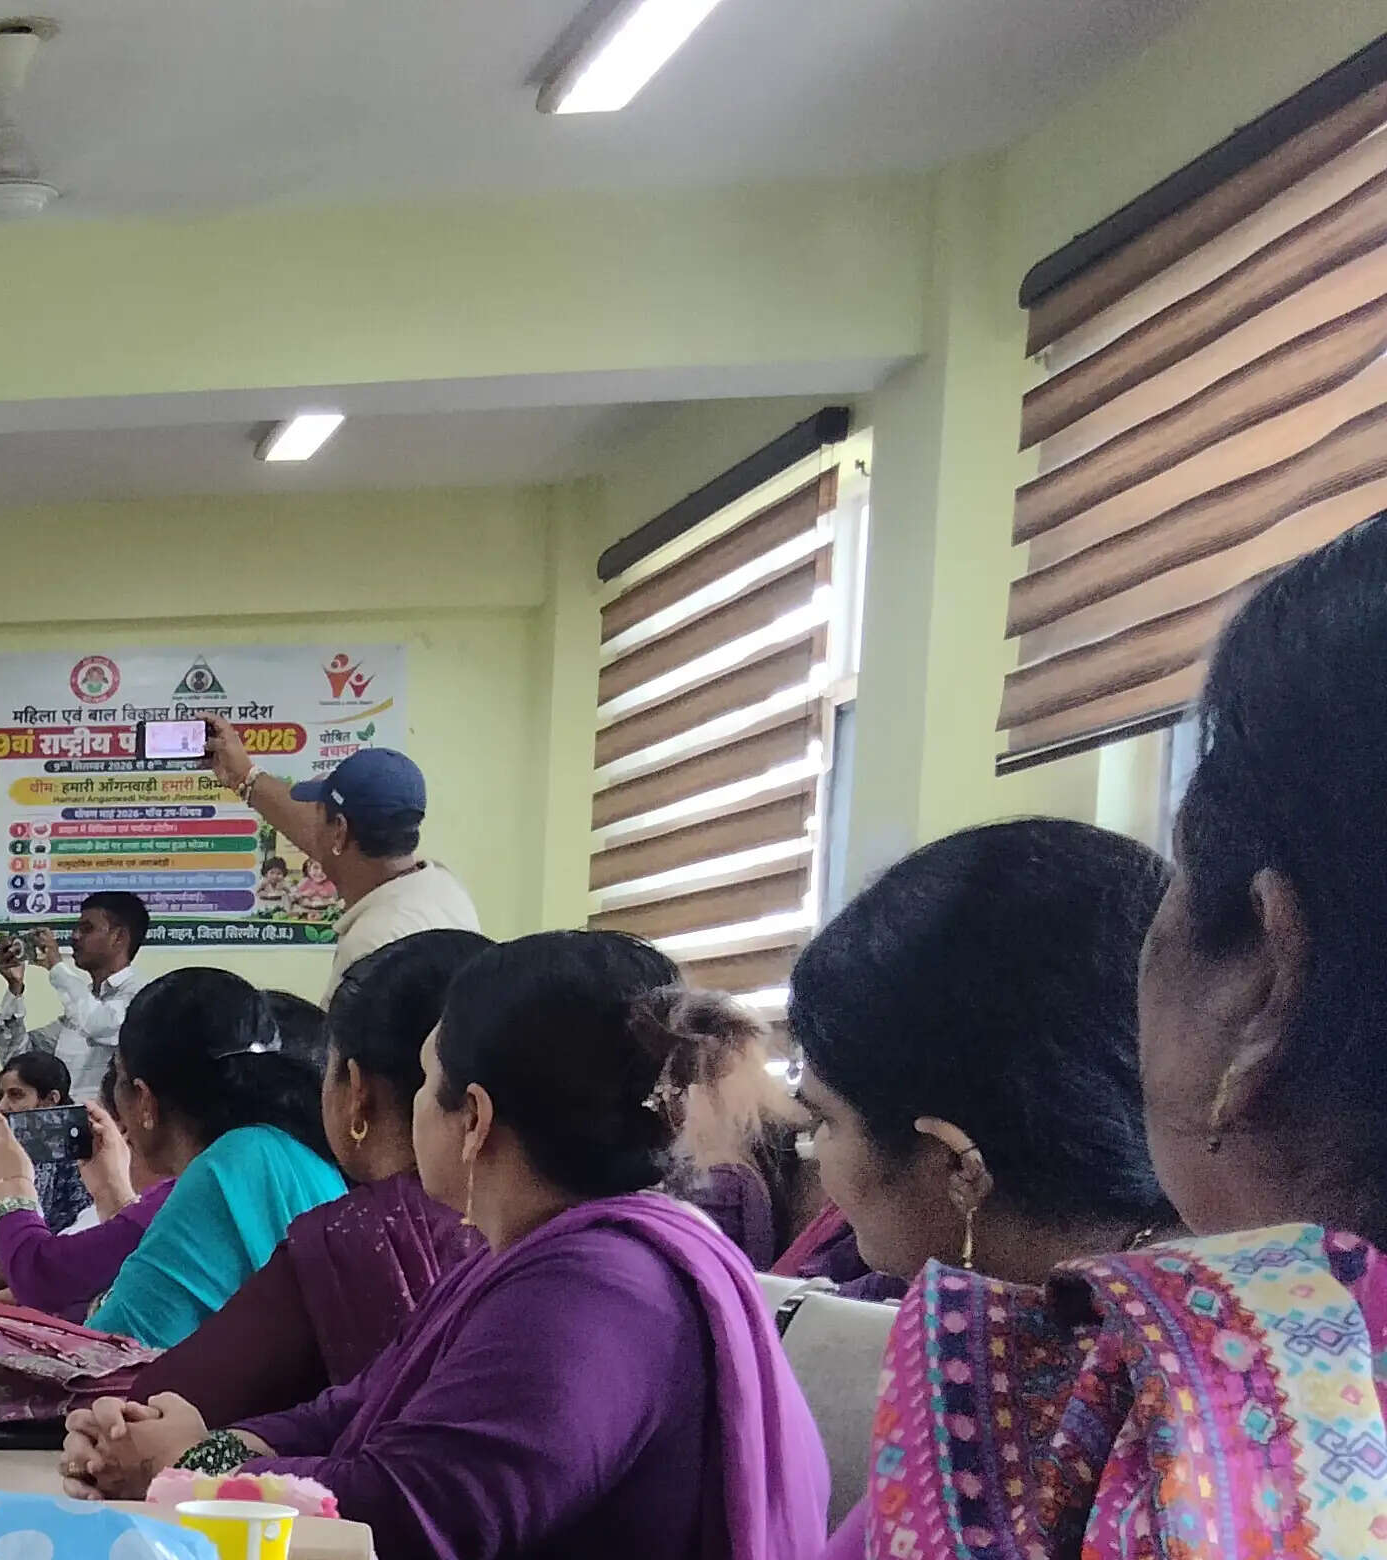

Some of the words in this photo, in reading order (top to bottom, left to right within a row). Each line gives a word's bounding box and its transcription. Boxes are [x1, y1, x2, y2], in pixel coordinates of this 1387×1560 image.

[12, 705, 56, 724] महिला
[62, 707, 83, 724] एवं
[88, 708, 117, 722] बाल
[122, 703, 169, 721] विकास
[238, 701, 274, 720] प्रदेश
[39, 726, 113, 758] राष्ट्रीय
[244, 728, 297, 752] 2026
[62, 778, 94, 794] हमारी
